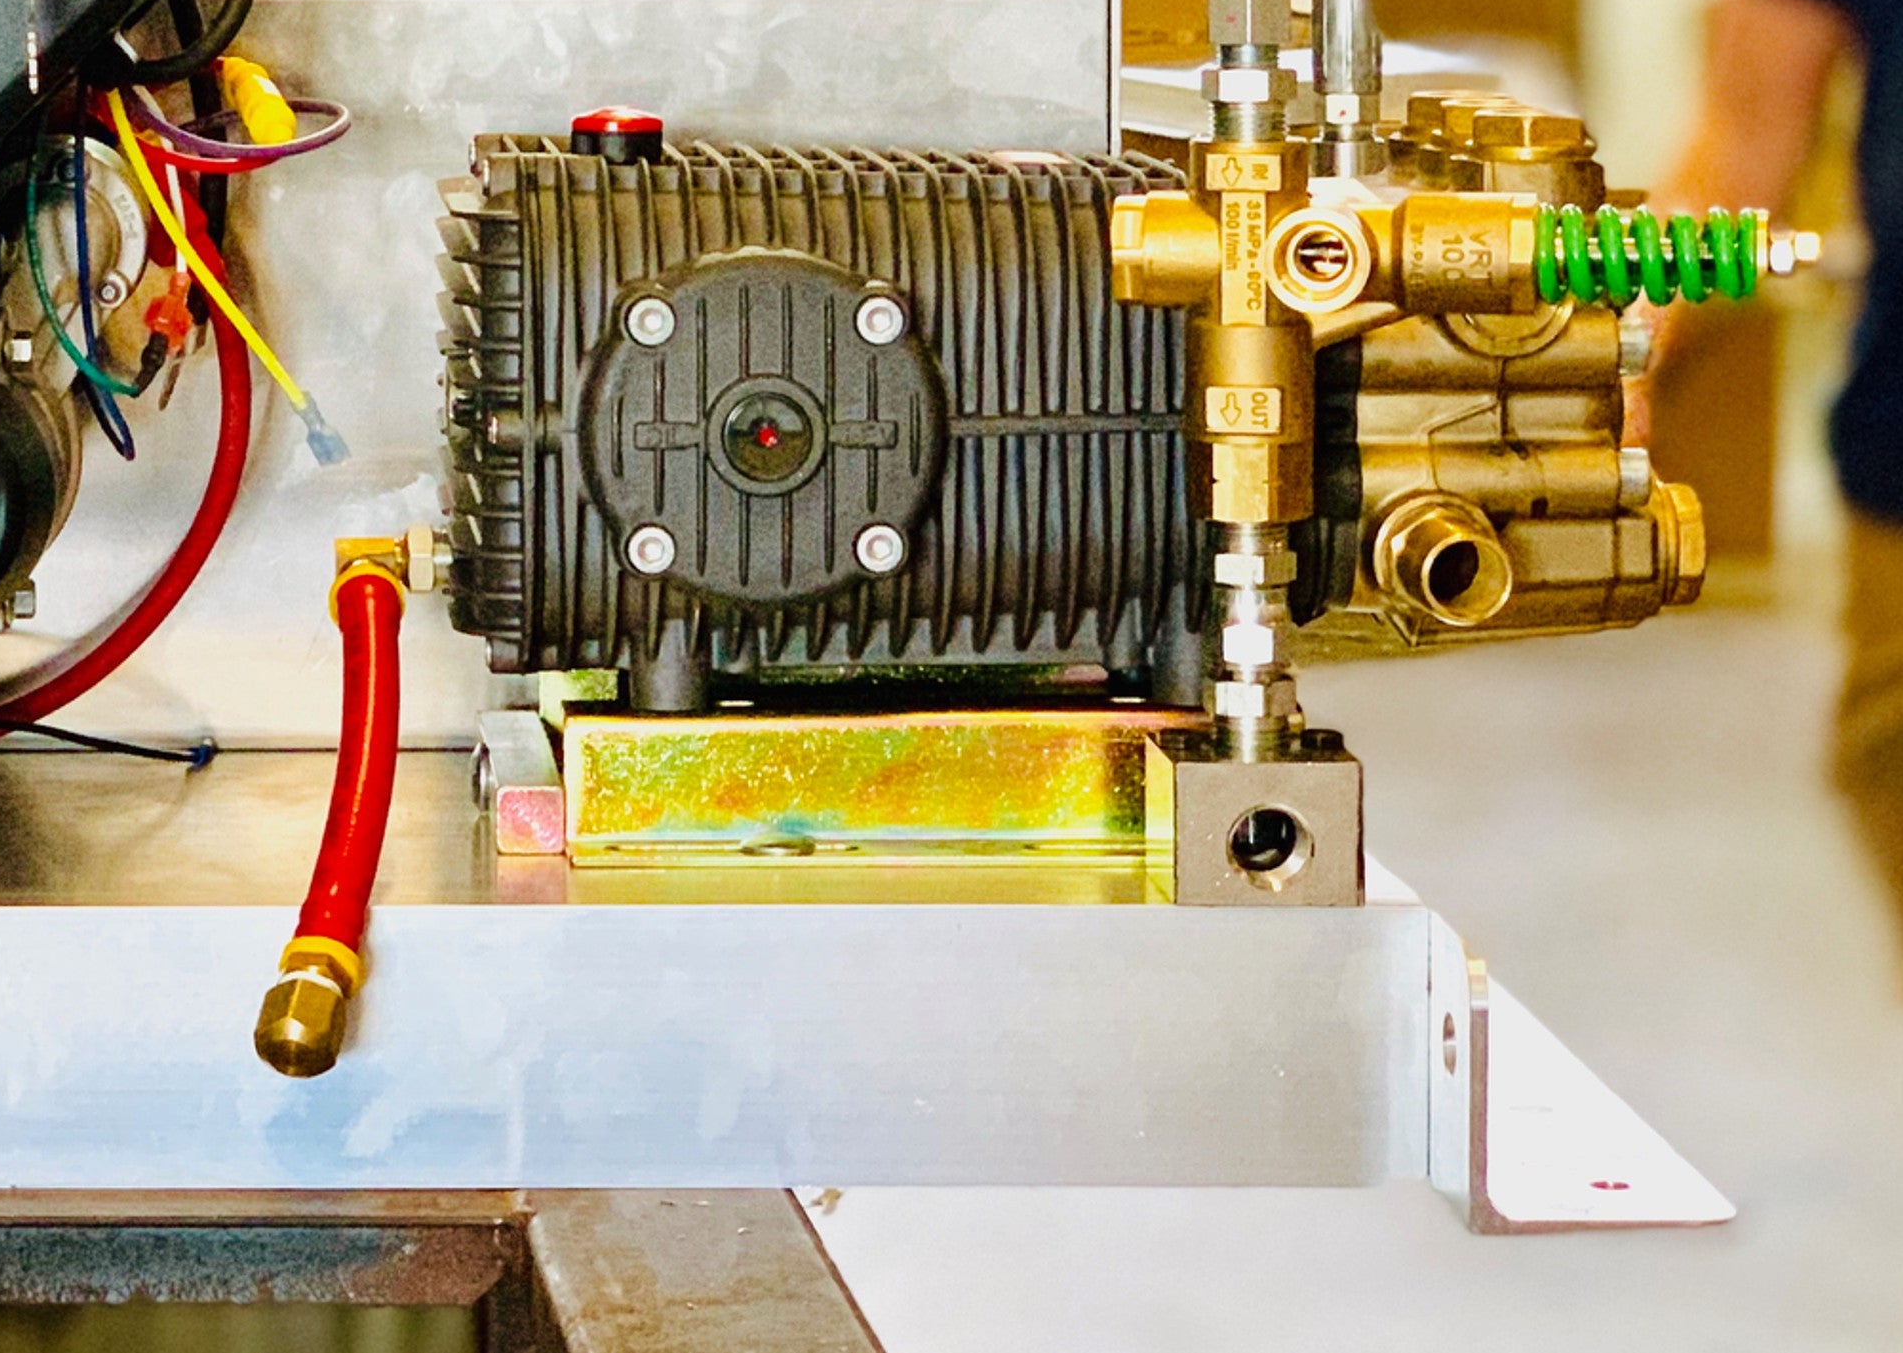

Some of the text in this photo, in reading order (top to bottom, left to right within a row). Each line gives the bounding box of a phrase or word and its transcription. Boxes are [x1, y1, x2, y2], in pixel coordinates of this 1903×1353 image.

[1251, 163, 1269, 180] IN
[1226, 201, 1240, 230] 100
[1246, 199, 1261, 221] 35
[1251, 391, 1269, 428] OUT
